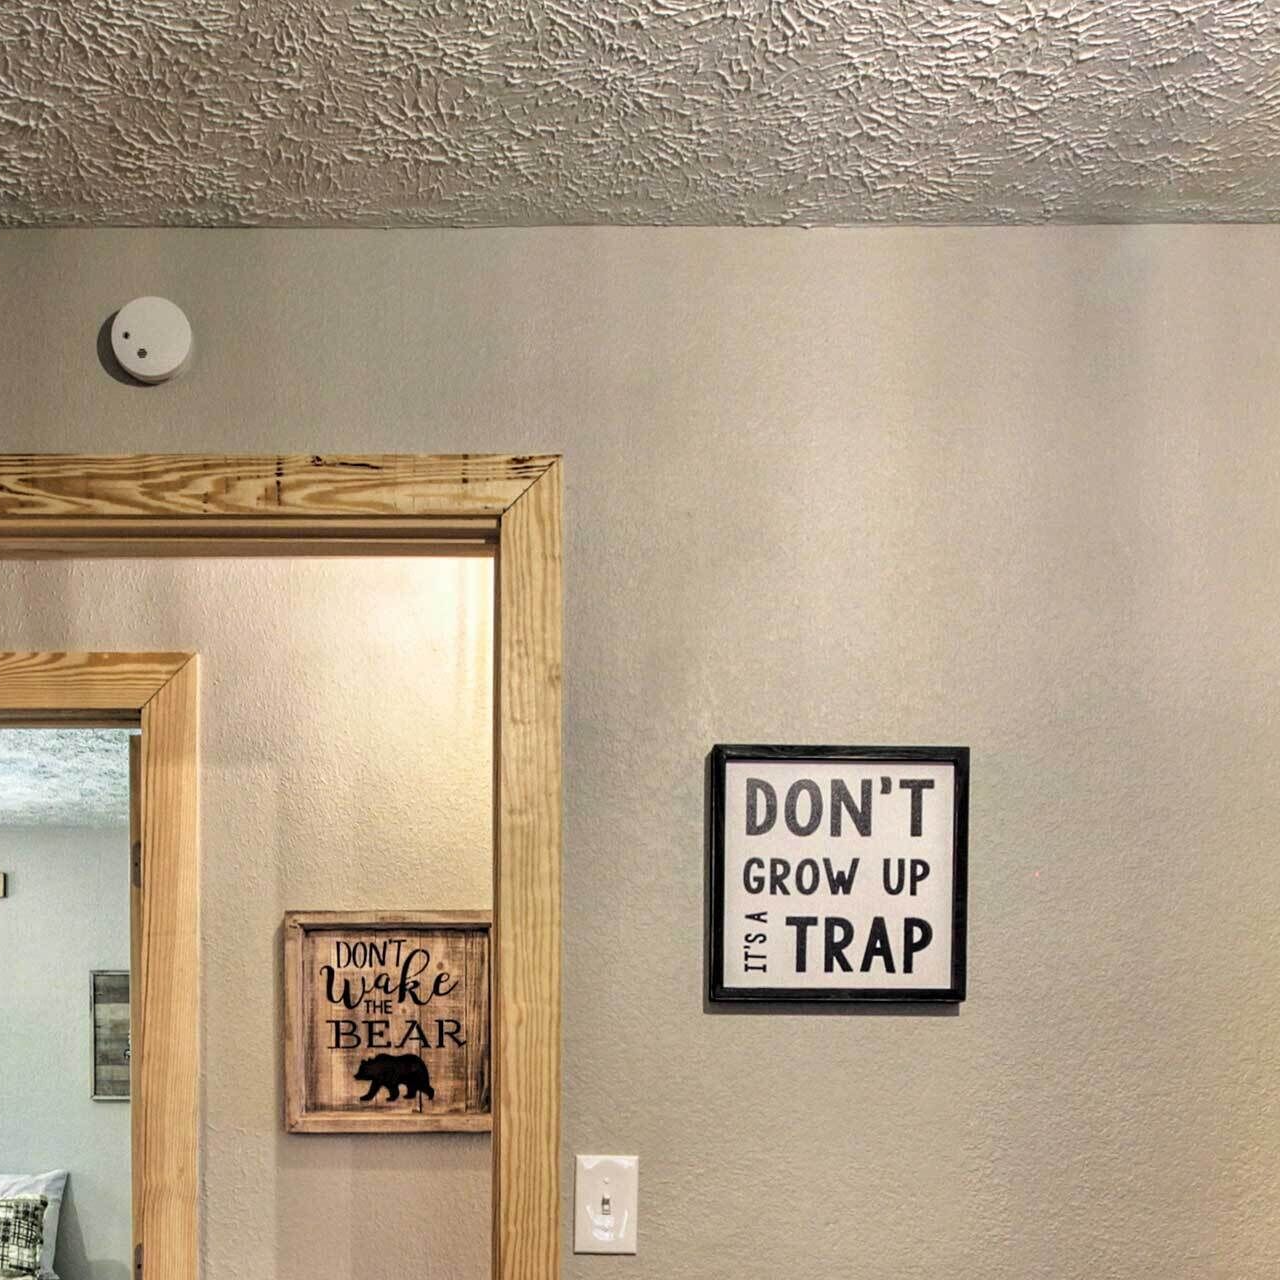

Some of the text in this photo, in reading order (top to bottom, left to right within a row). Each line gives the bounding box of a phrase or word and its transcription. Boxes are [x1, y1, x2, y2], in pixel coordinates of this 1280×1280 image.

[744, 776, 936, 838] DON'T
[741, 856, 931, 897] GROW UP
[335, 938, 407, 969] DON'T
[743, 910, 769, 973] IT'S A
[785, 916, 934, 975] TRAP
[364, 999, 393, 1015] THE
[326, 1018, 468, 1050] BEAR
